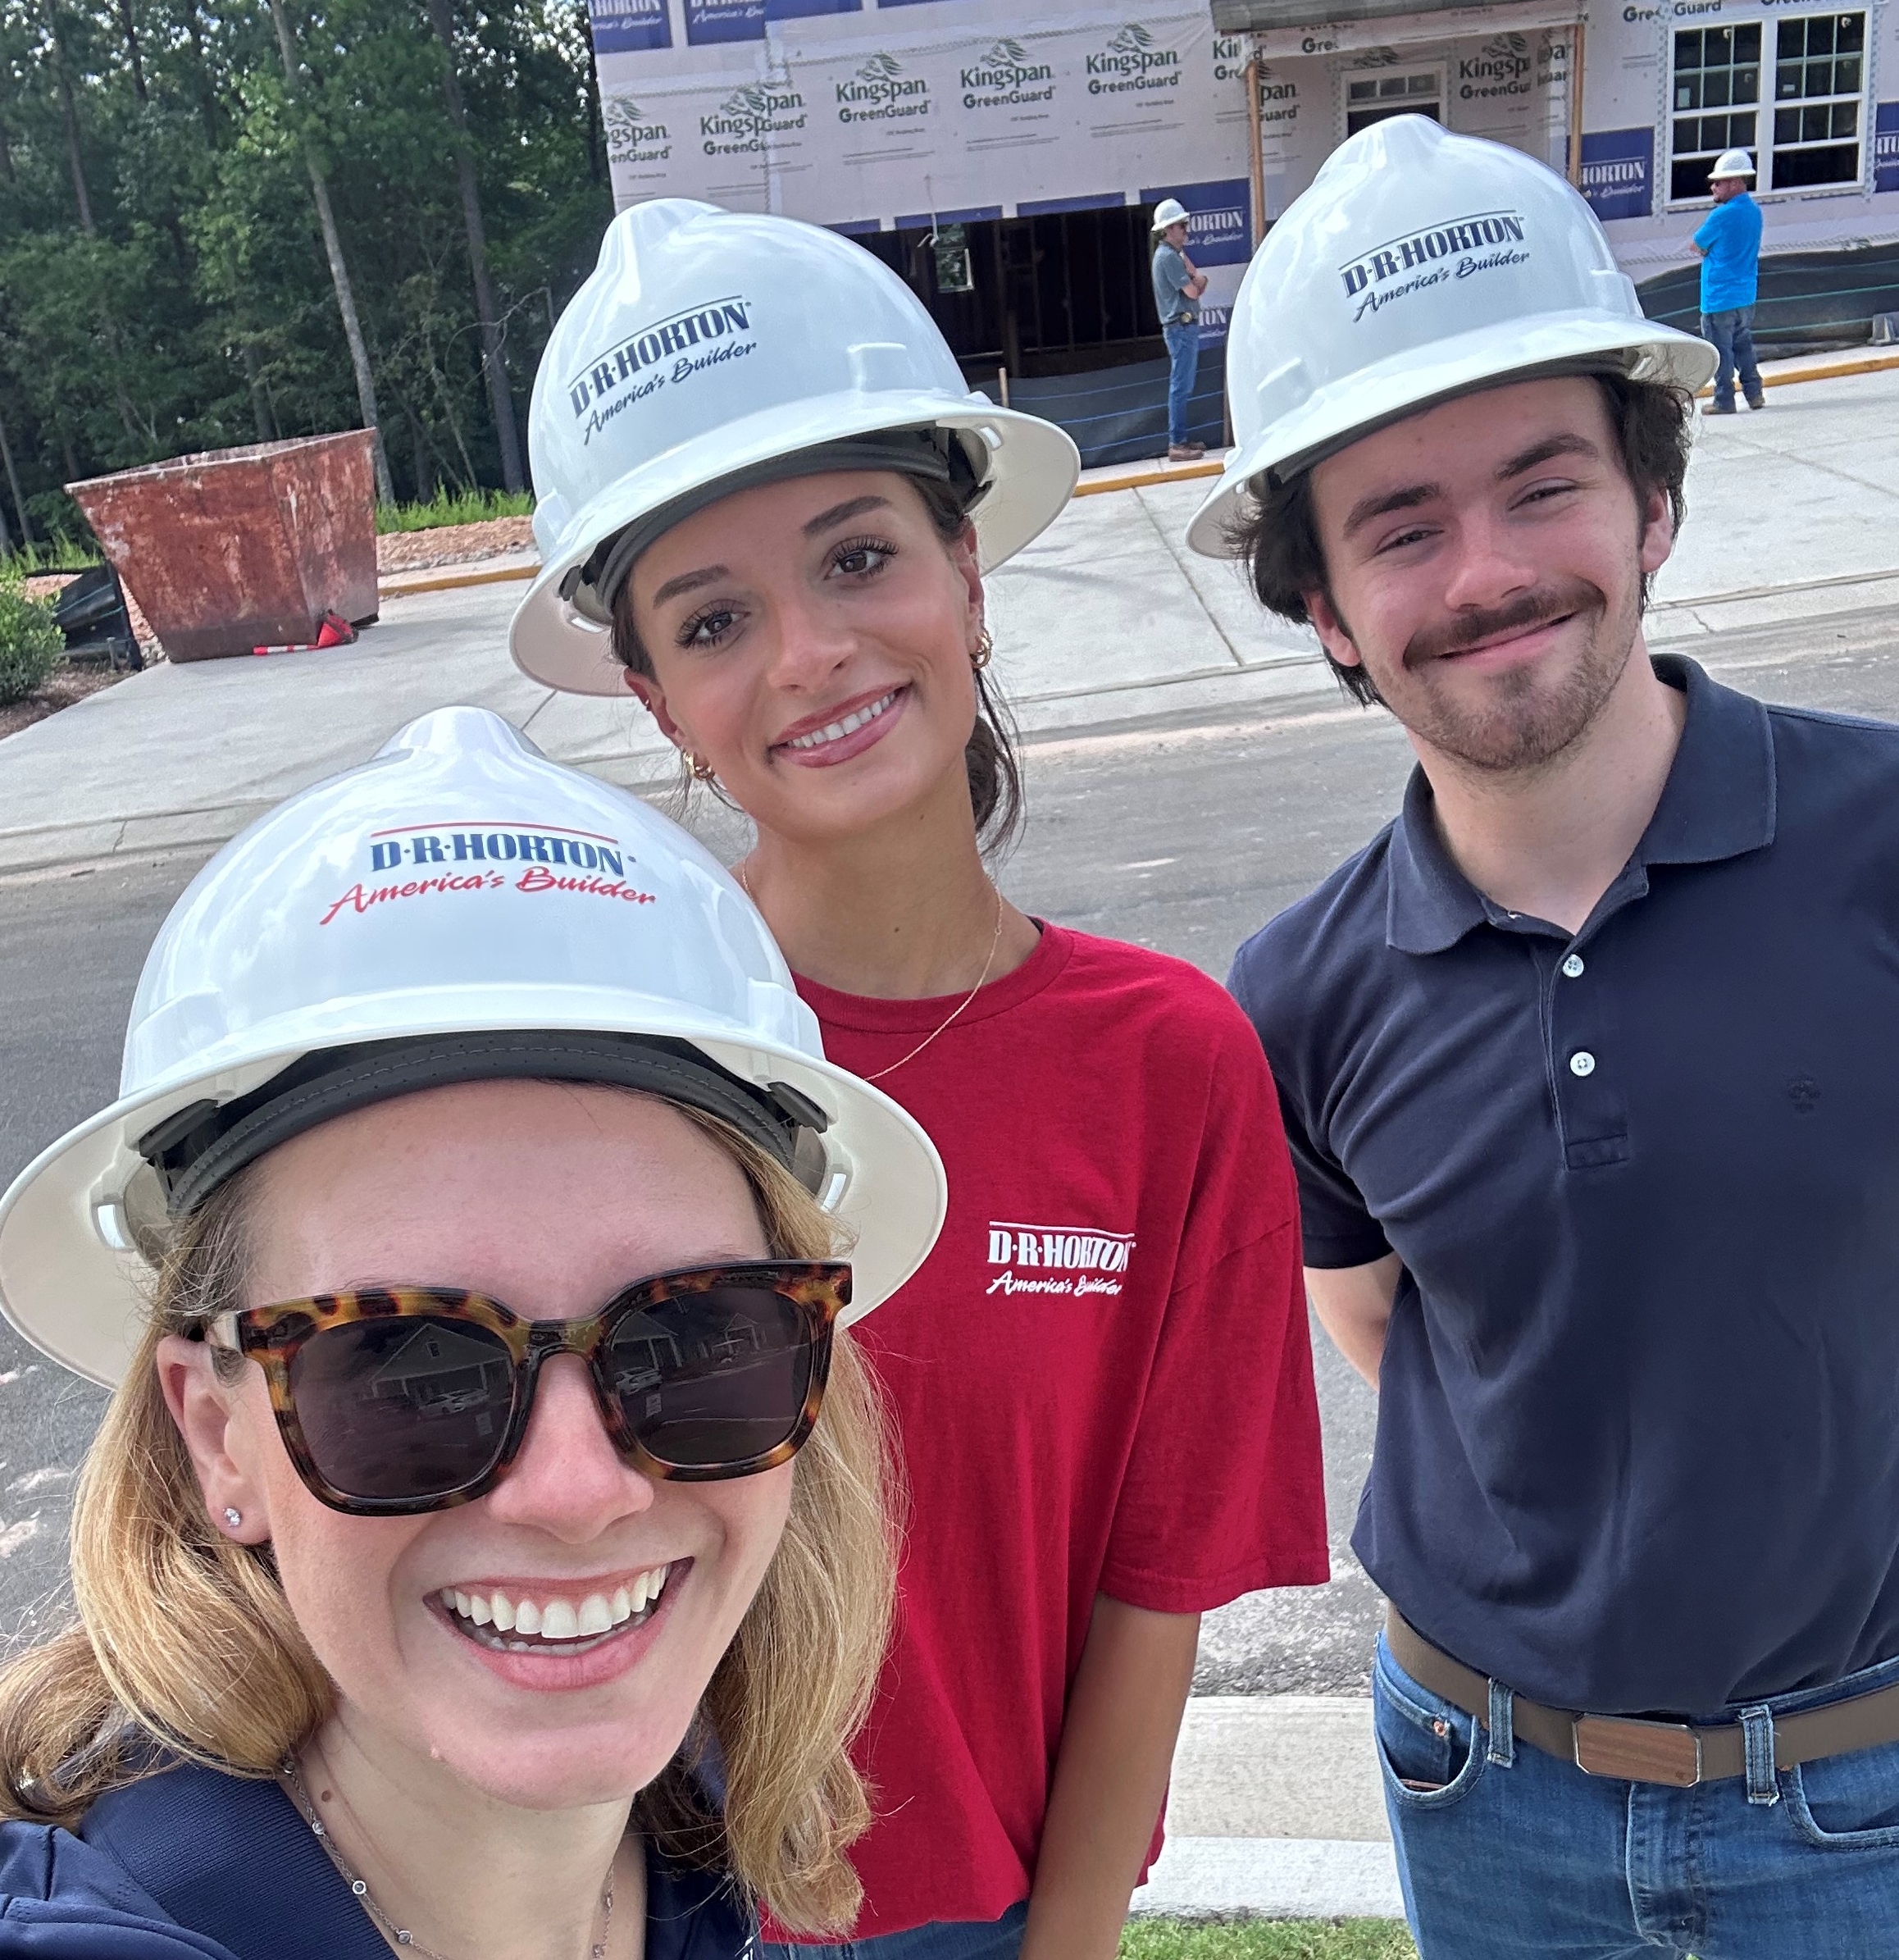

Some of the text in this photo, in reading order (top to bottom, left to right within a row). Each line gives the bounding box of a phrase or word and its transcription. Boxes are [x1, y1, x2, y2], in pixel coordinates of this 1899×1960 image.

[1674, 0, 1721, 16] Guard
[1302, 37, 1333, 53] Gre
[1086, 50, 1177, 75] Kingspan
[1460, 57, 1531, 81] Kingsp
[961, 65, 1051, 89] Kingspan
[1088, 73, 1179, 94] GreenGuard
[836, 79, 927, 104] Kingspan
[963, 87, 1053, 109] GreenGuard
[1260, 83, 1296, 107] pan
[839, 102, 928, 123] GreenGuard
[610, 125, 667, 148] gspan
[700, 115, 767, 139] Kingsp
[610, 146, 669, 163] enGuard
[1353, 249, 1530, 322] America's Builder
[584, 341, 757, 446] America's Builder
[320, 866, 656, 925] America's Builder
[986, 1270, 1123, 1297] America's Builder
